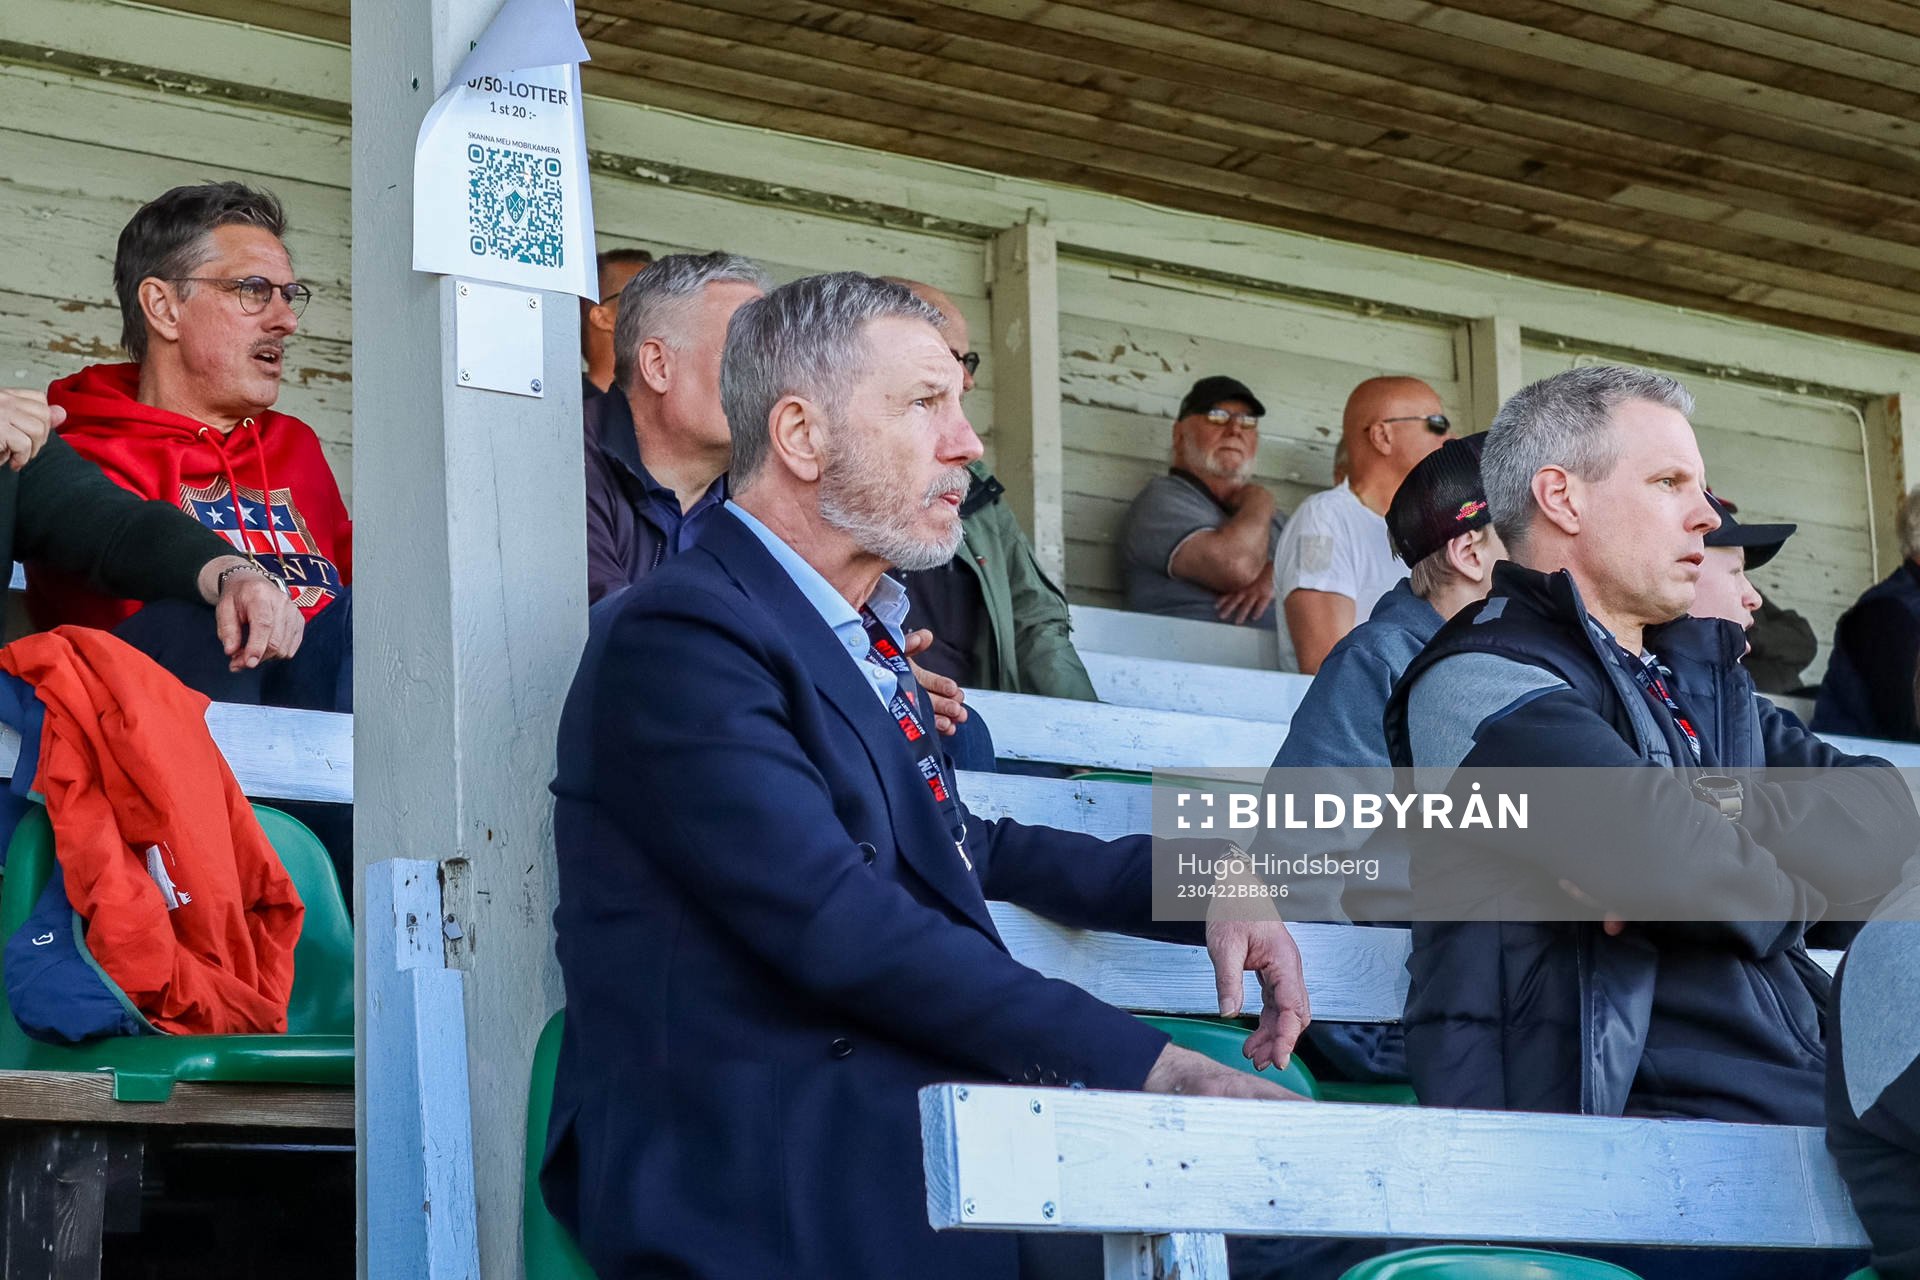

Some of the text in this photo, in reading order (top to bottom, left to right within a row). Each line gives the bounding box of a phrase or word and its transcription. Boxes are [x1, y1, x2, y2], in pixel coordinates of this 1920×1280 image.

[490, 101, 496, 113] 1
[499, 105, 509, 116] st
[512, 106, 526, 118] 20
[467, 131, 495, 143] SKANNA
[512, 140, 561, 155] MOBILKAMERA
